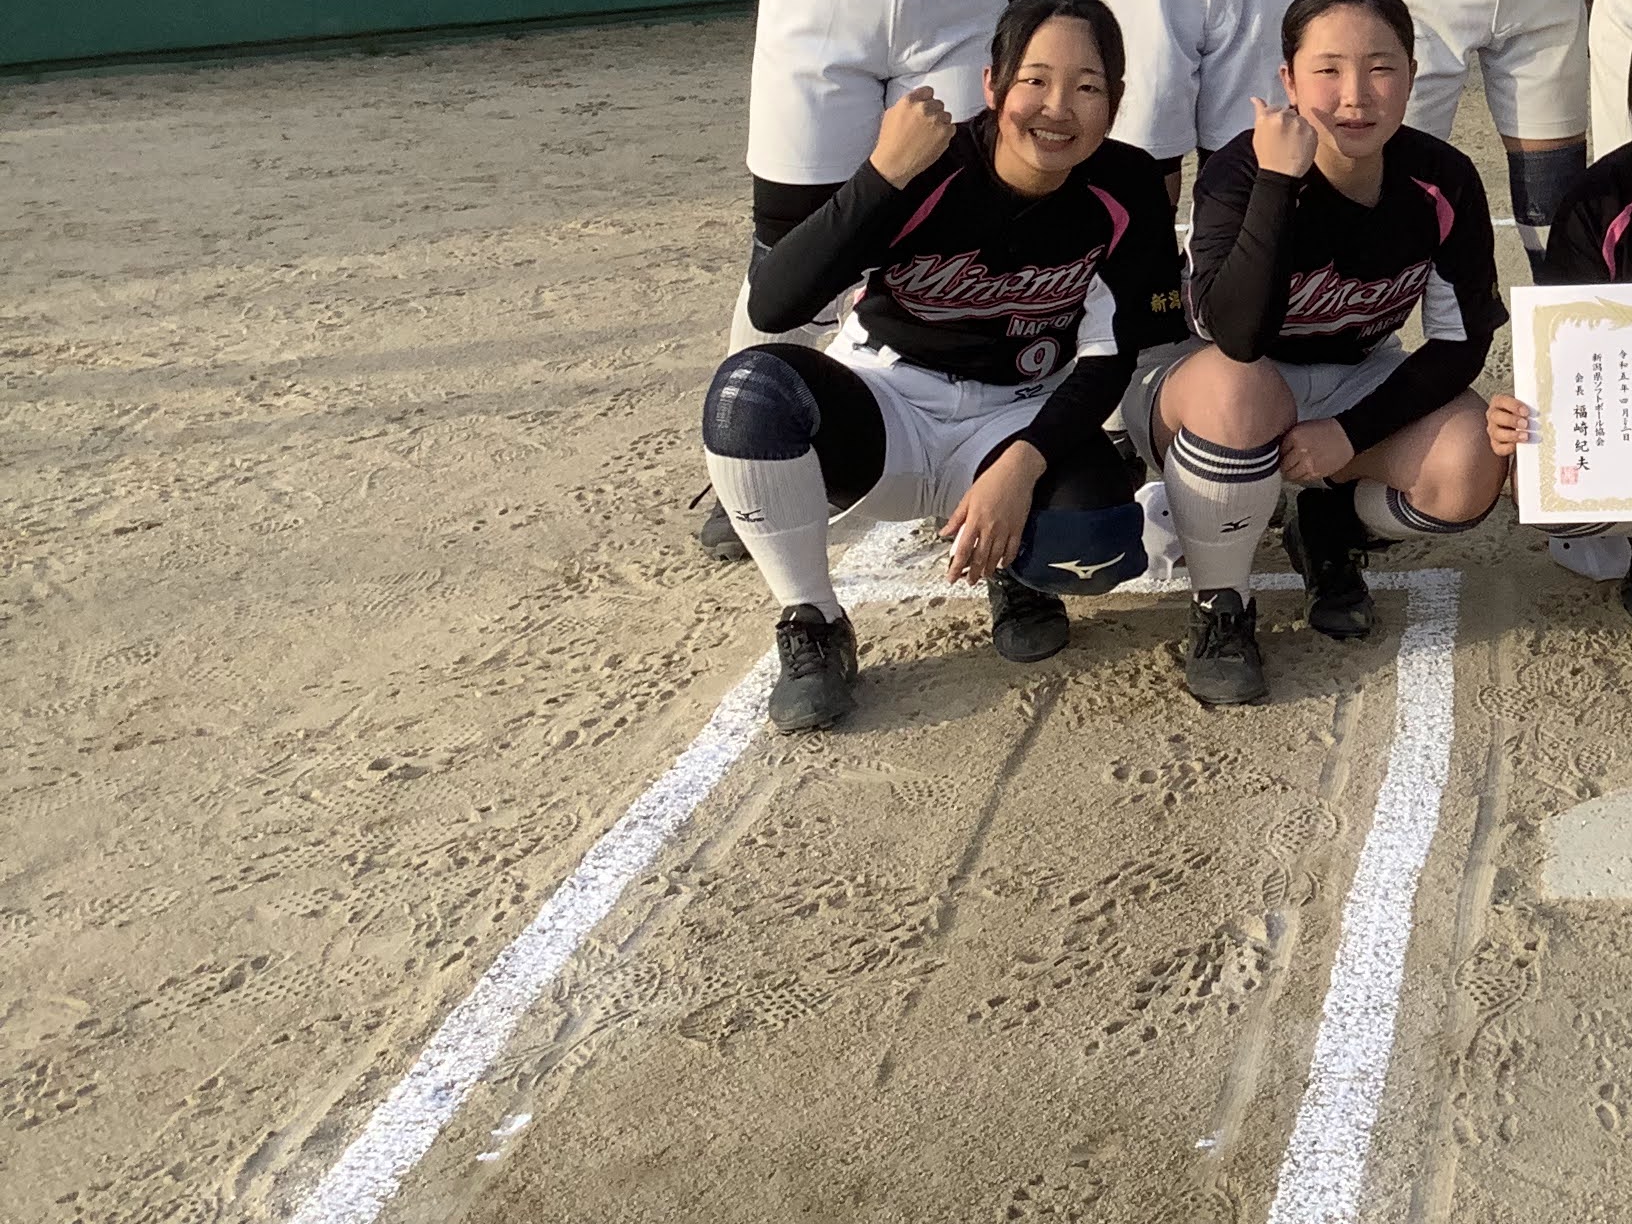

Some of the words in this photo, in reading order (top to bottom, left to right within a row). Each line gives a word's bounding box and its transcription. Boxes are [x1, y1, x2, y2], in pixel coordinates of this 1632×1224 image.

[885, 246, 1105, 300] Minami
[1016, 337, 1060, 383] 9
[1592, 353, 1605, 447] 新潟県ソフトボール協会
